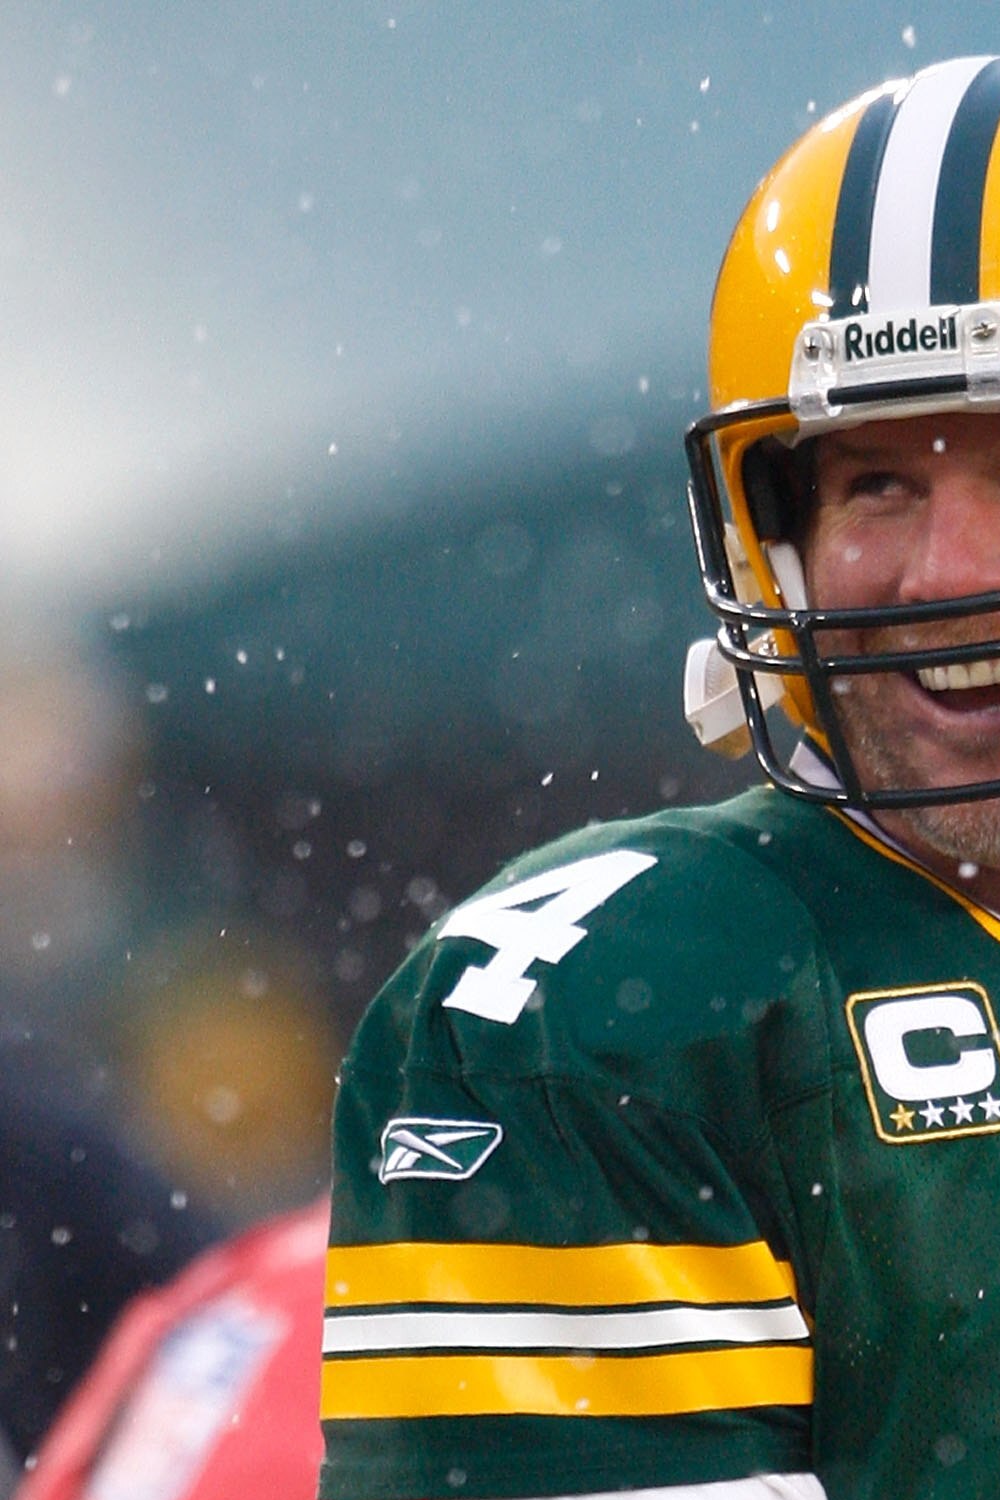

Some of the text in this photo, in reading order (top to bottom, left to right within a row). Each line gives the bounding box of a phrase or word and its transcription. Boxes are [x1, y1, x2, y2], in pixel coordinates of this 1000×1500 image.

[844, 317, 957, 361] Riddell
[437, 850, 658, 1024] 4
[864, 996, 996, 1101] C
